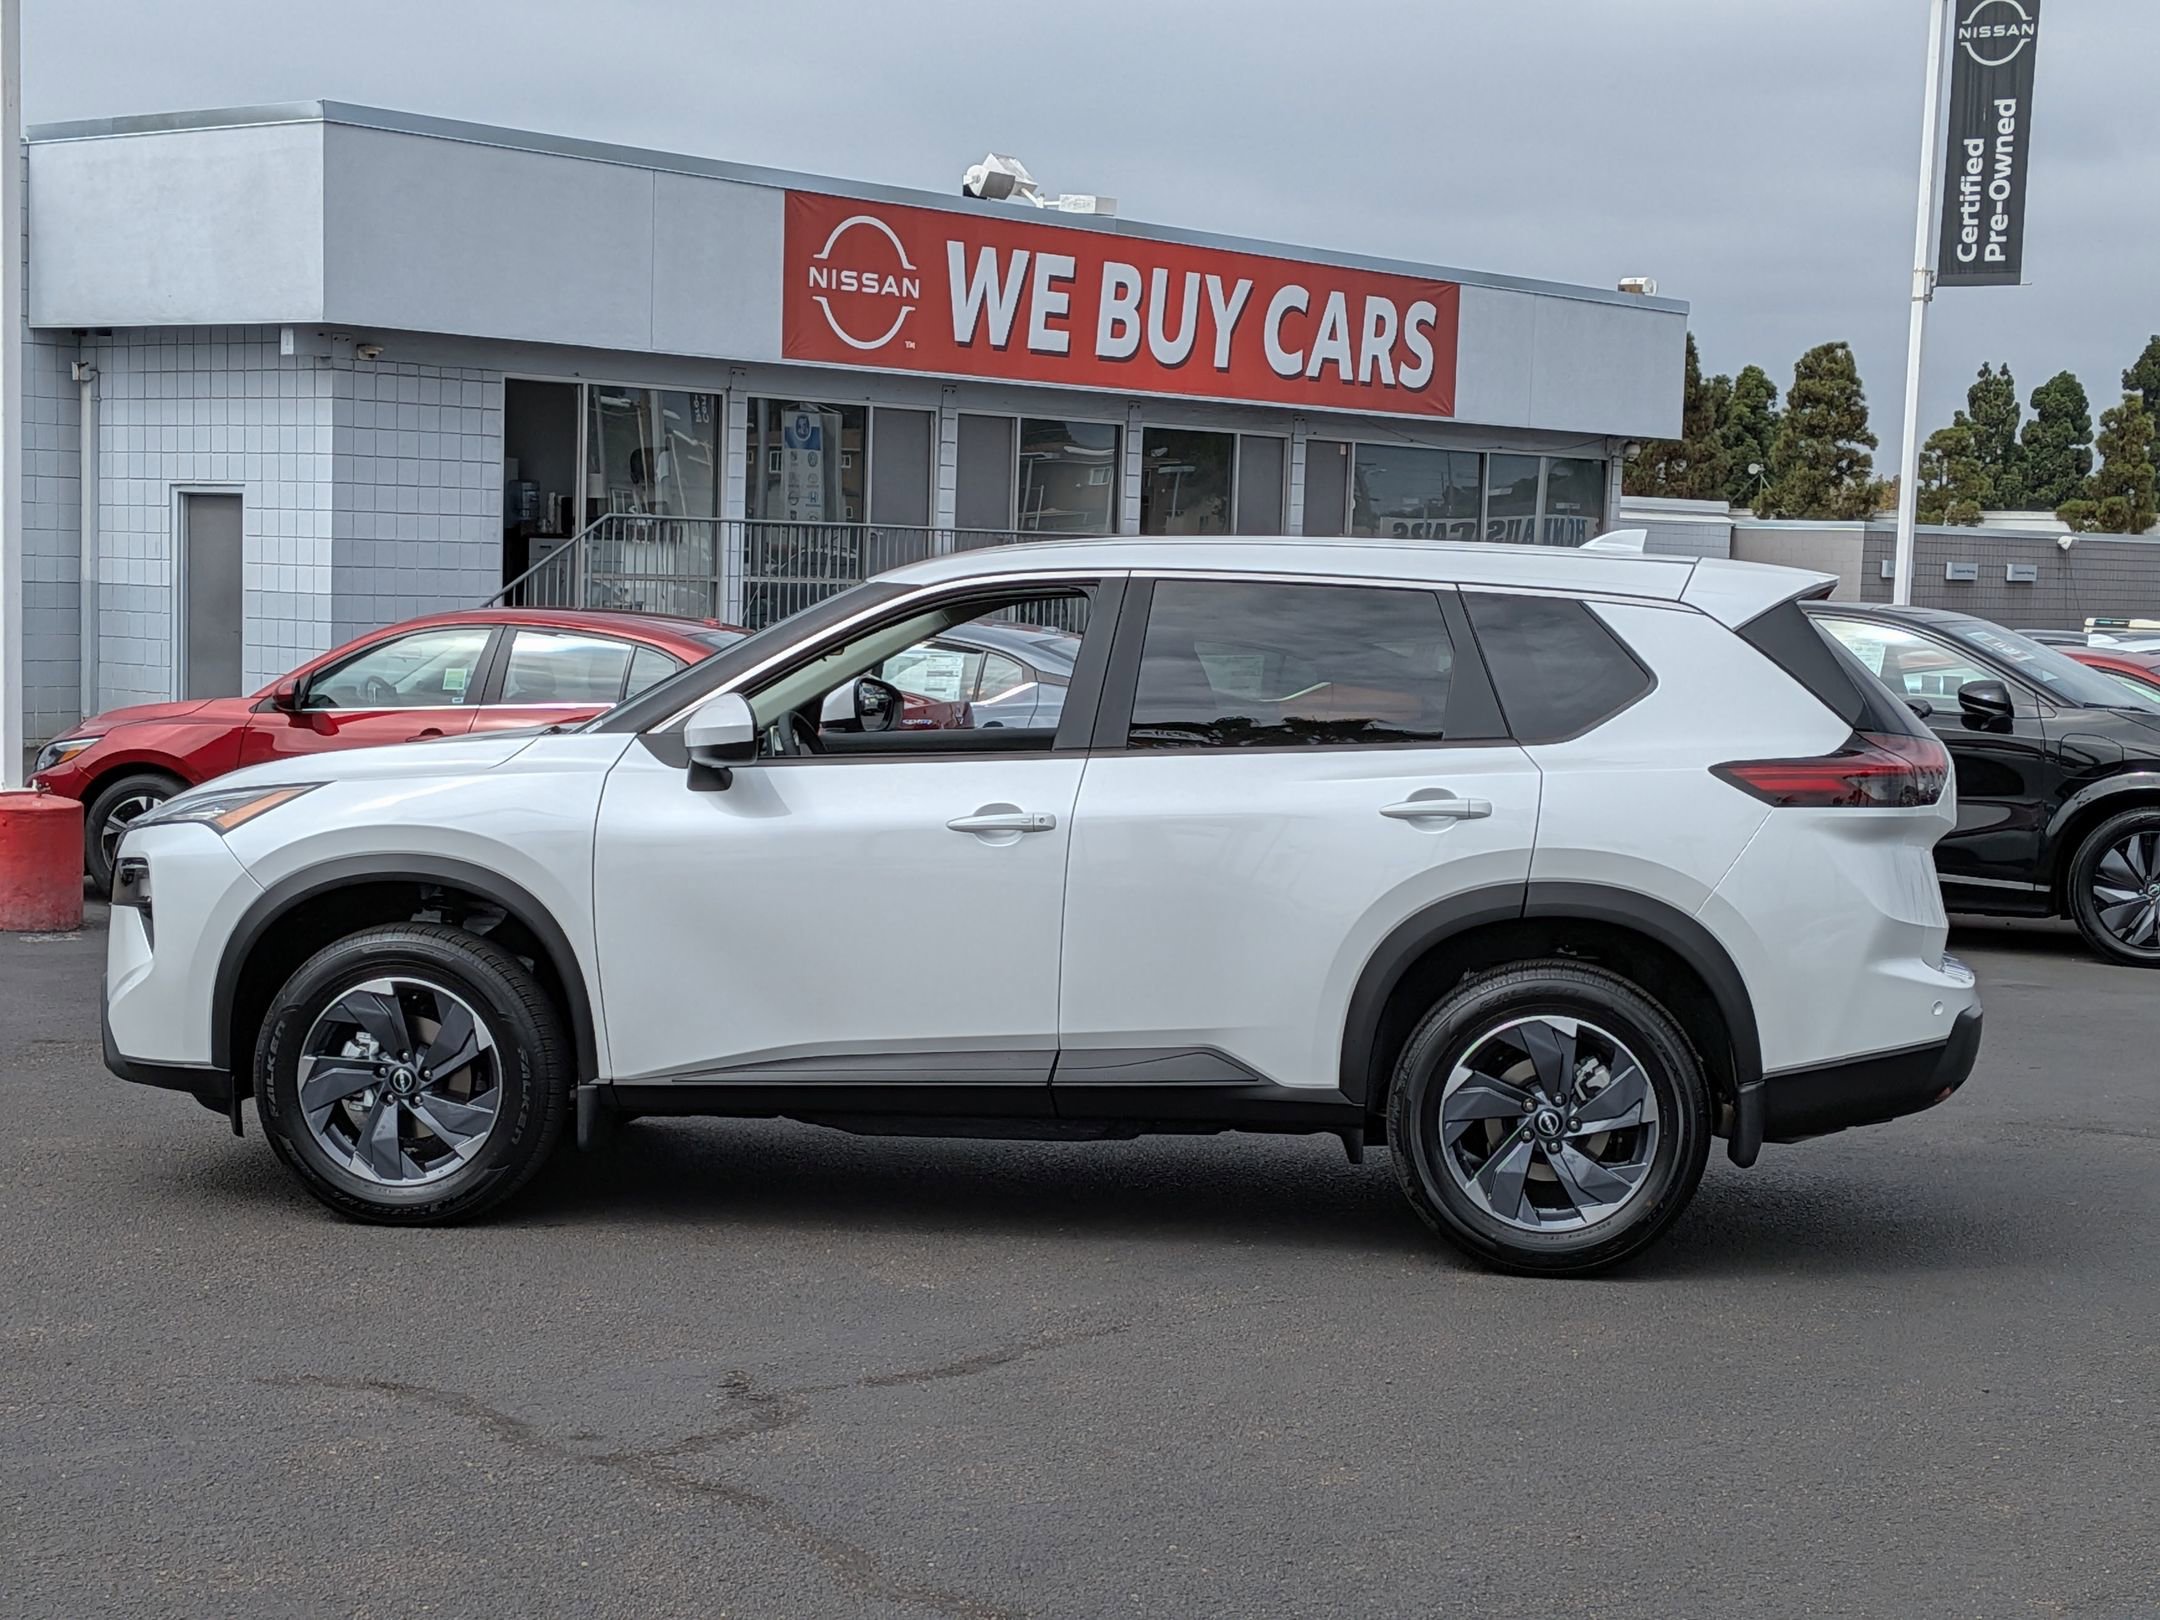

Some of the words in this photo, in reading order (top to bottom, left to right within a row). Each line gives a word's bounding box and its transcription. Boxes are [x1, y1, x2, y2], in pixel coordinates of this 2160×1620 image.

[1958, 23, 2035, 39] NISSAN
[1956, 138, 1985, 263] Certified
[1984, 98, 2017, 262] Pre-Owned
[809, 265, 921, 299] NISSAN
[946, 240, 1077, 354] WE
[1096, 261, 1254, 369] BUY
[1263, 284, 1438, 390] CARS
